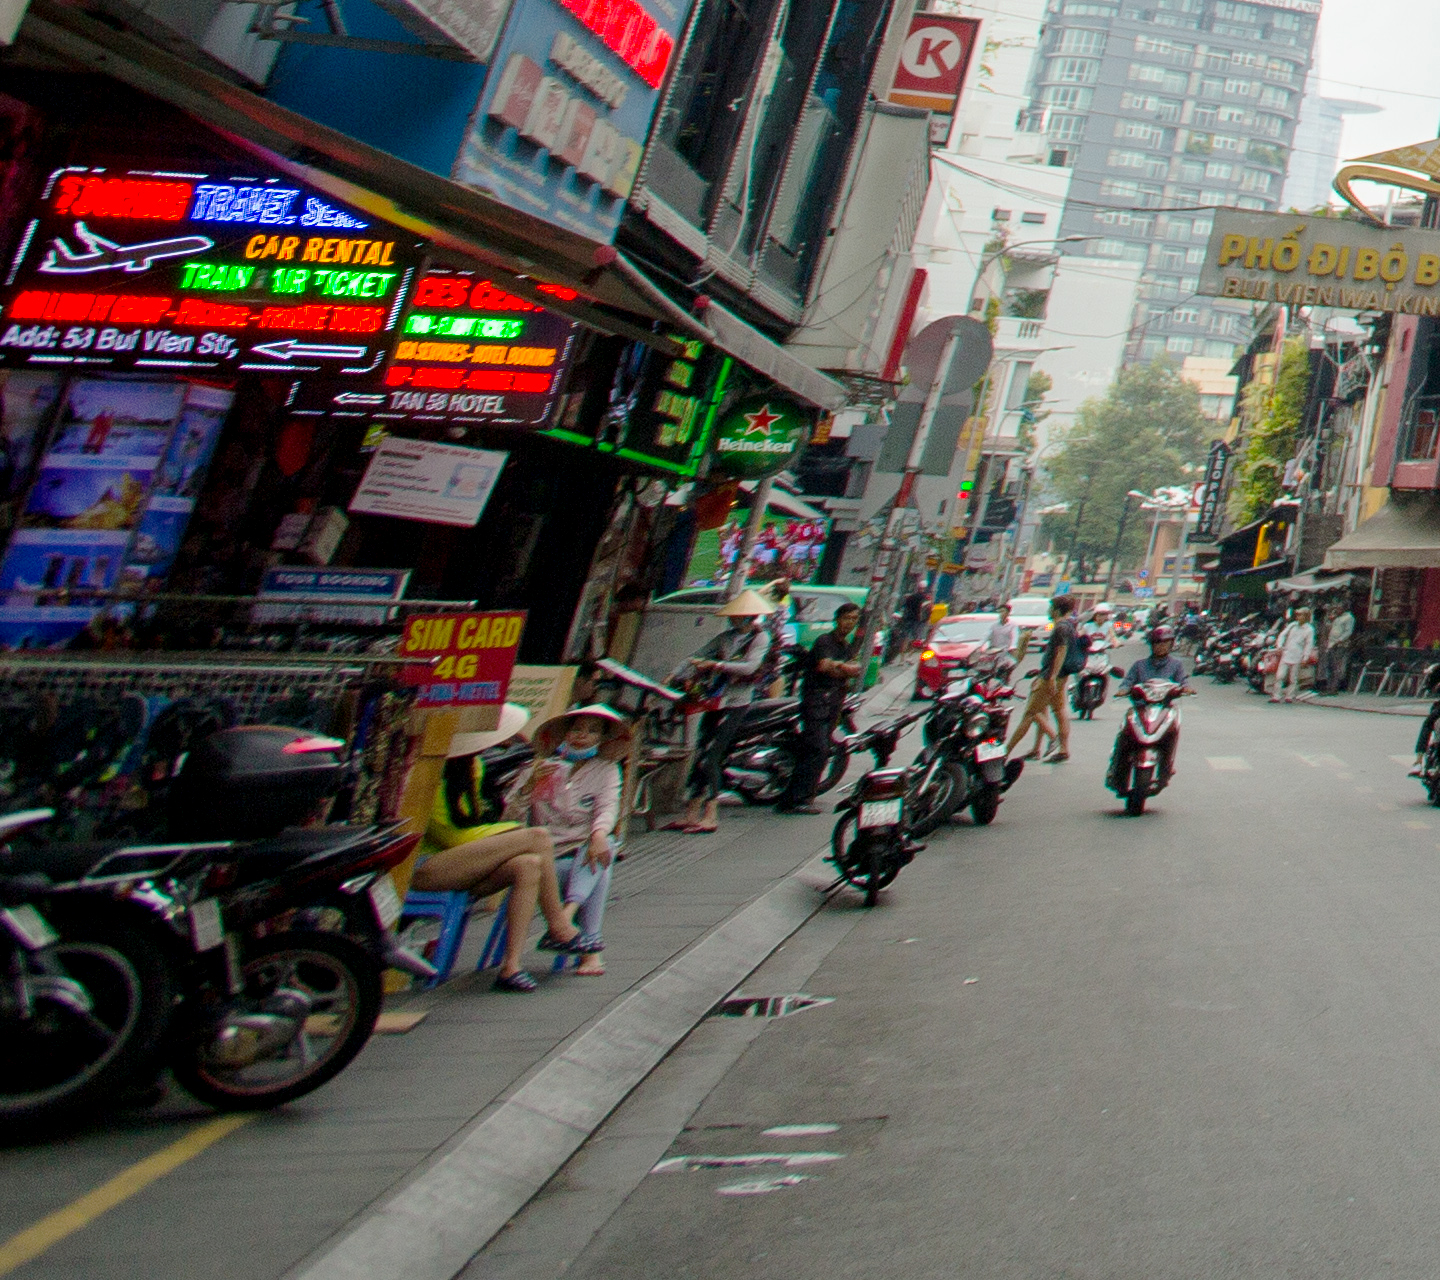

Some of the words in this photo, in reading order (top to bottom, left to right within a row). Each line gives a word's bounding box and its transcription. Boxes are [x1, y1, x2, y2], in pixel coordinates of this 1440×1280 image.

[245, 235, 301, 261] CAR
[302, 237, 396, 266] RENTAL
[1217, 224, 1306, 272] PHỐ
[1308, 244, 1348, 278] ĐI
[1353, 242, 1409, 292] BỘ
[143, 329, 196, 354] Vien
[447, 393, 506, 415] HOTEL
[717, 437, 796, 453] Heineken
[405, 618, 457, 653] SIM
[456, 616, 523, 651] CARD
[432, 654, 480, 680] 4G
